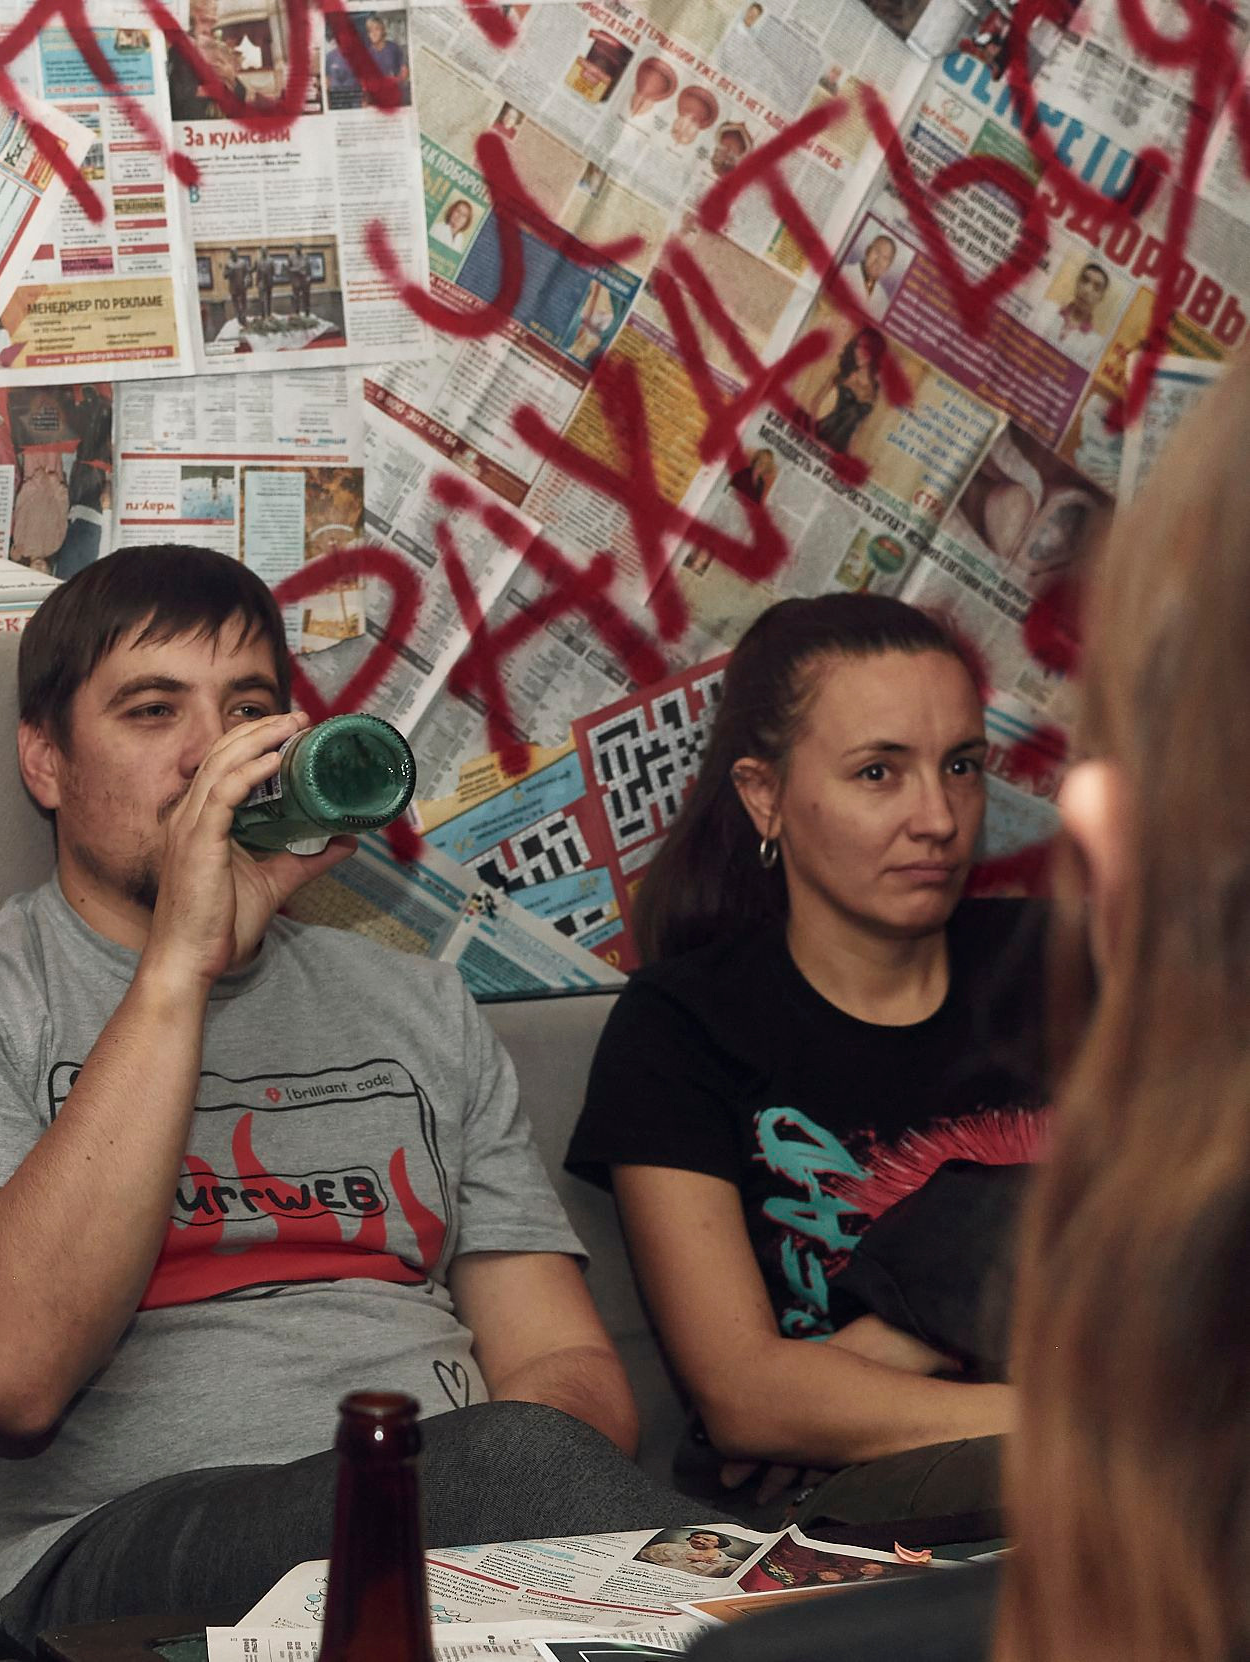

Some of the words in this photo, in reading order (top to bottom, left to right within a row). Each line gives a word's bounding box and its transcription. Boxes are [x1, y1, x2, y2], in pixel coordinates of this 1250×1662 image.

[184, 127, 204, 147] За
[27, 297, 92, 315] МЕНЕДЖЕР
[94, 298, 110, 311] ПО
[112, 295, 163, 310] РЕКЛАМЕ
